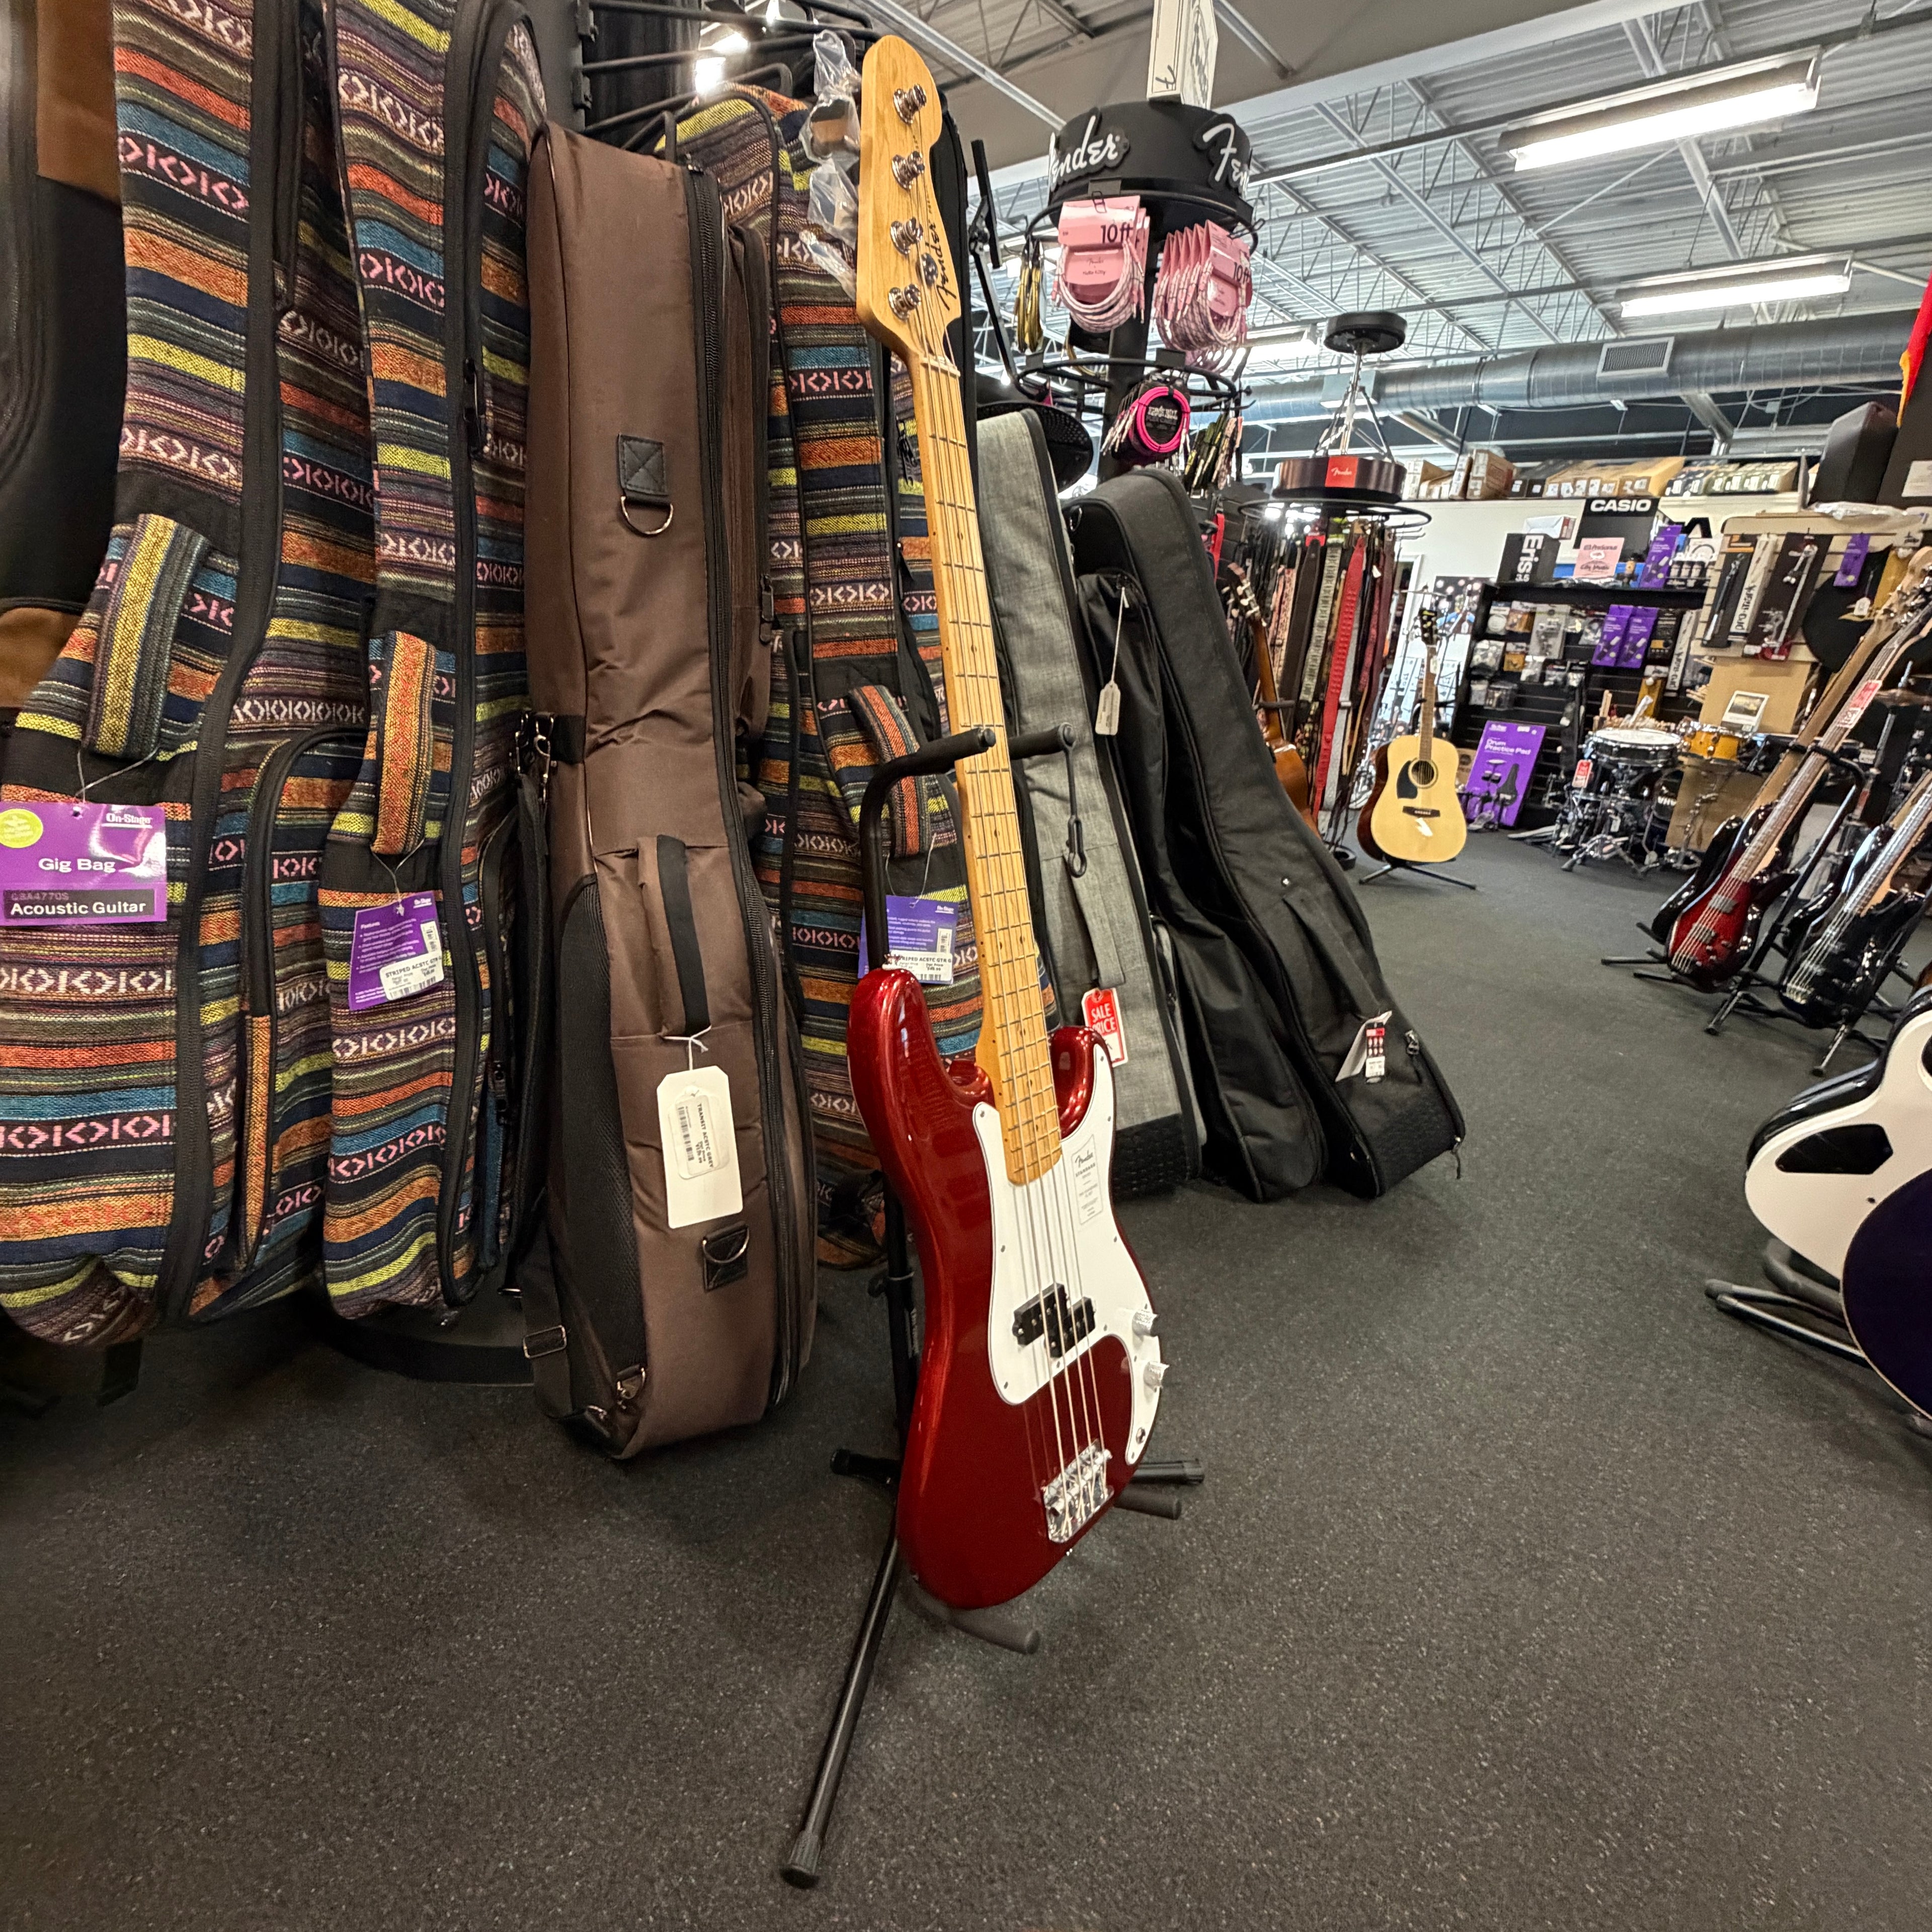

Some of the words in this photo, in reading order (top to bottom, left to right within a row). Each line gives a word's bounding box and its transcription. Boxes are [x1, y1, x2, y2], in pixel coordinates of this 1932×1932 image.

[1202, 123, 1249, 190] Fen
[1100, 221, 1134, 244] 10ft
[926, 222, 957, 310] Fender
[1331, 467, 1352, 476] Fender
[1590, 499, 1651, 512] CASIO
[1517, 535, 1545, 574] Eris
[1484, 745, 1514, 753] Practice
[106, 813, 152, 825] On-Stage
[38, 857, 72, 873] Gig
[77, 858, 116, 873] Bag
[10, 903, 89, 916] Acoustic
[92, 901, 146, 915] Guitar
[385, 966, 411, 978] STRIPED
[1091, 1003, 1111, 1023] SALE
[1092, 1017, 1116, 1034] PRICE
[697, 1103, 707, 1130] TRANSIT
[1075, 1149, 1093, 1168] Fender
